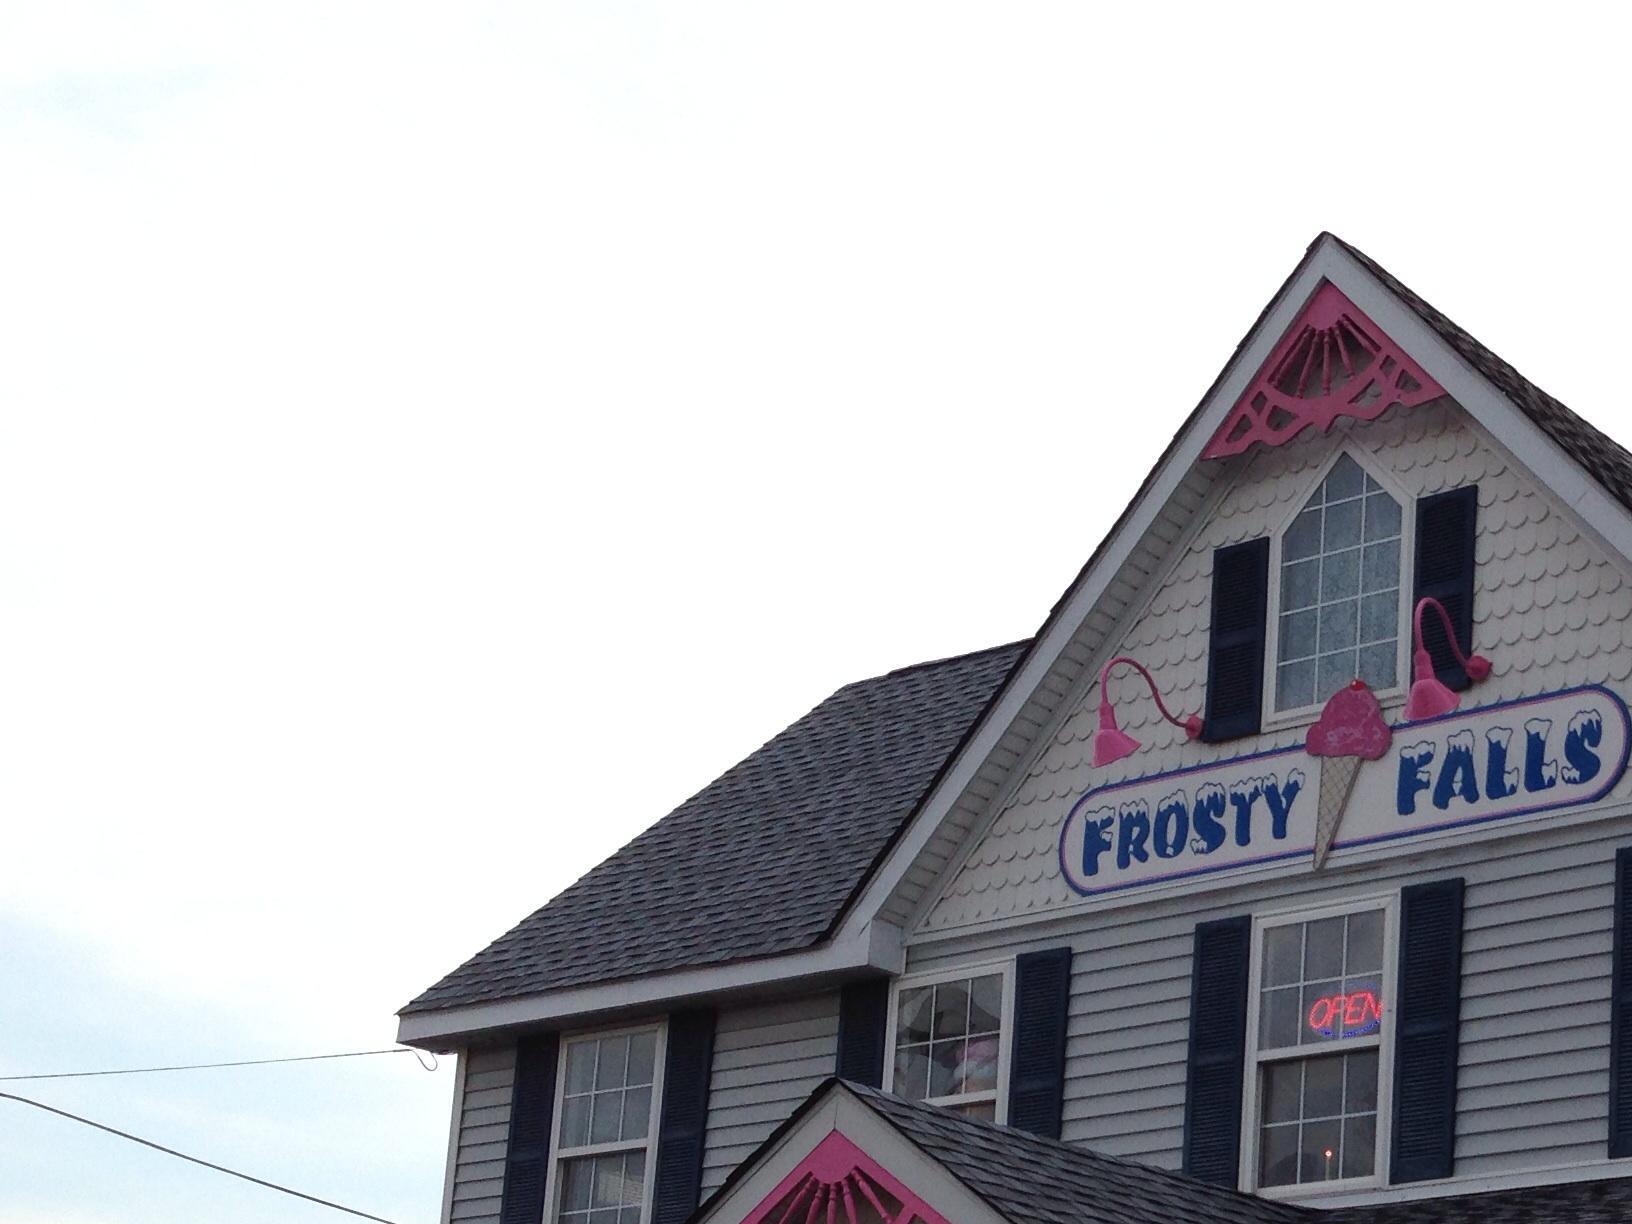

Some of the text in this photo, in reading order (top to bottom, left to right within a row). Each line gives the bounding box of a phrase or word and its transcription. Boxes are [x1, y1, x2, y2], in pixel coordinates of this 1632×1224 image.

[1082, 709, 1602, 876] FROSTY FALLS
[1308, 991, 1384, 1030] OPEN
